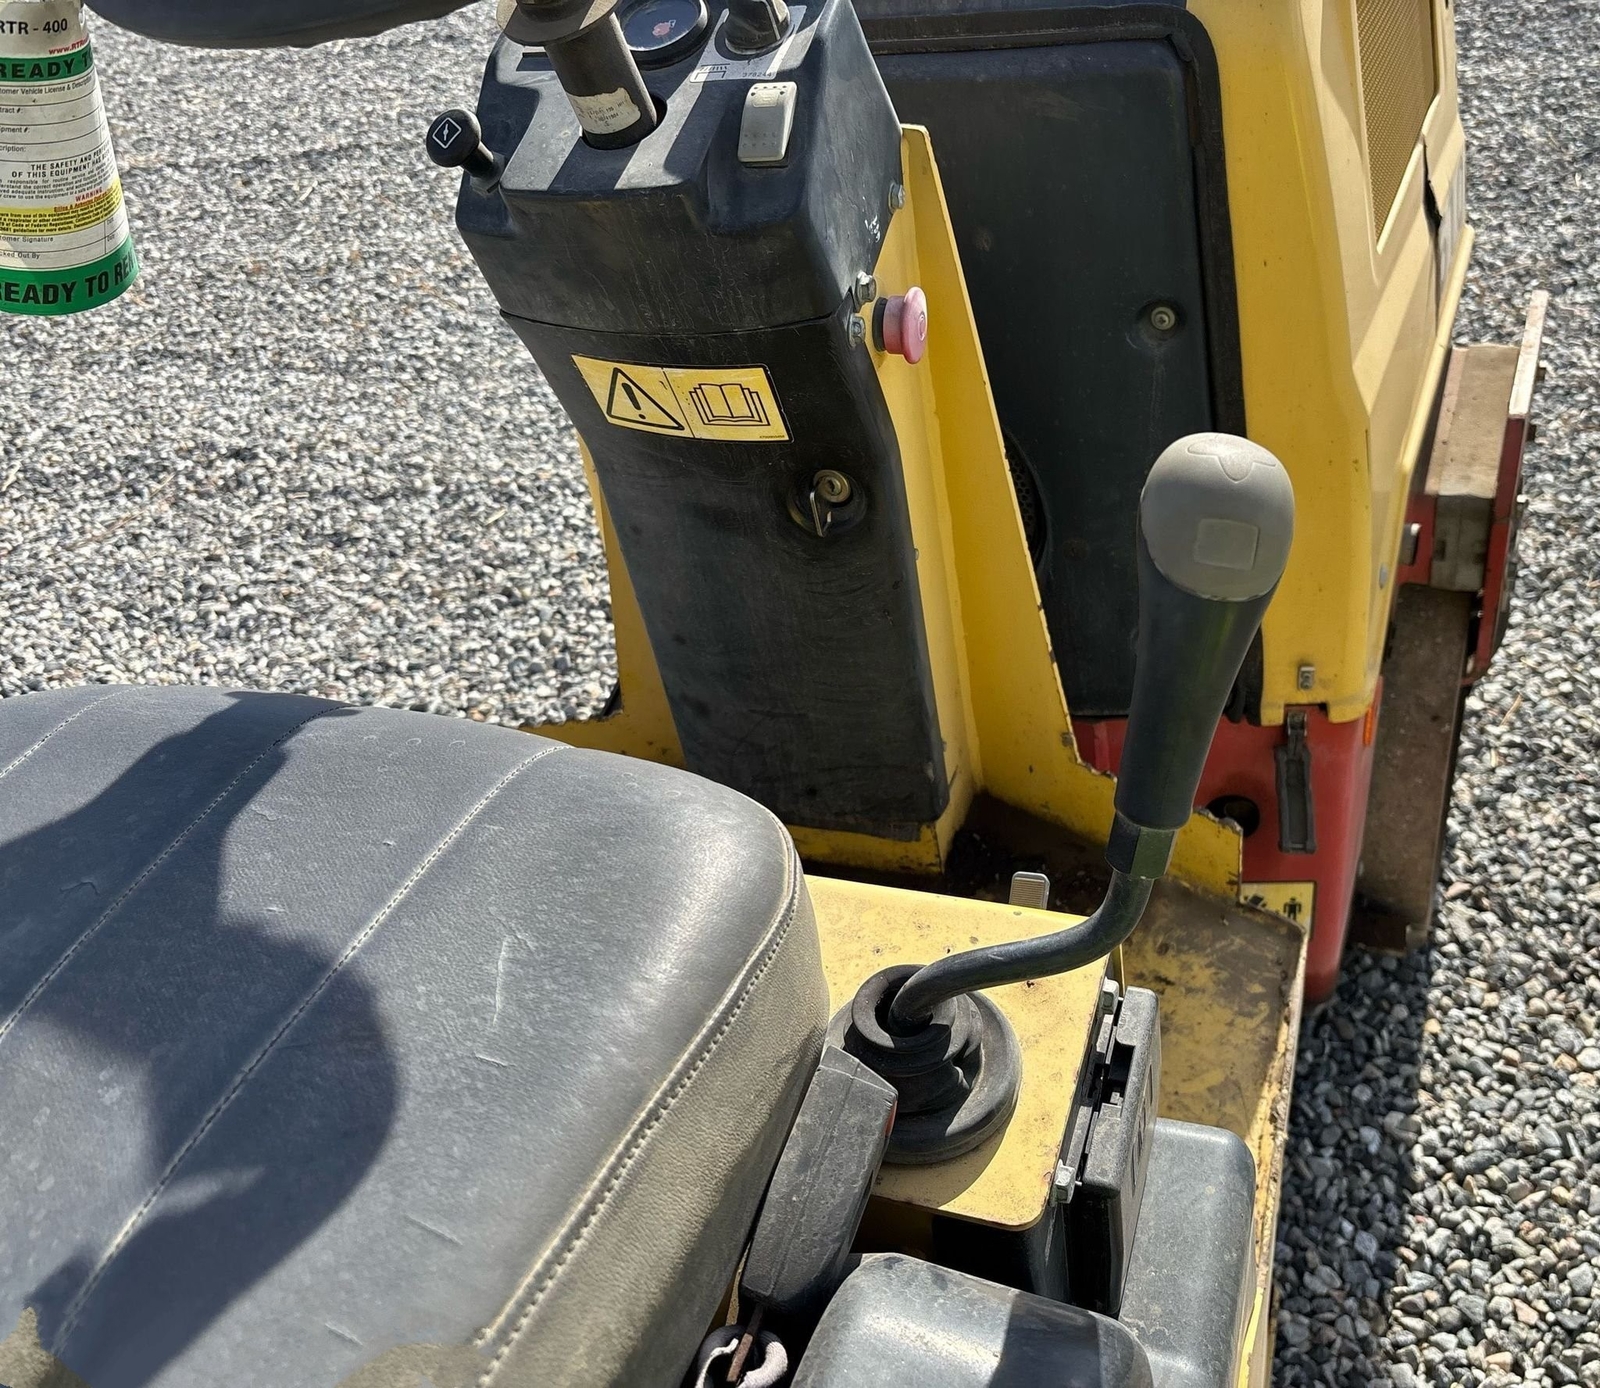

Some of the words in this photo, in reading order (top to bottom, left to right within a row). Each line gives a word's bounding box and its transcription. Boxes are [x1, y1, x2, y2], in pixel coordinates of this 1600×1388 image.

[42, 18, 68, 33] 400
[50, 159, 77, 170] SAFETY
[80, 154, 91, 163] AND
[50, 162, 90, 177] EQUIPMENT
[75, 187, 102, 202] WARNING
[0, 281, 76, 304] EADY
[85, 271, 108, 298] TO
[114, 248, 135, 286] REN
